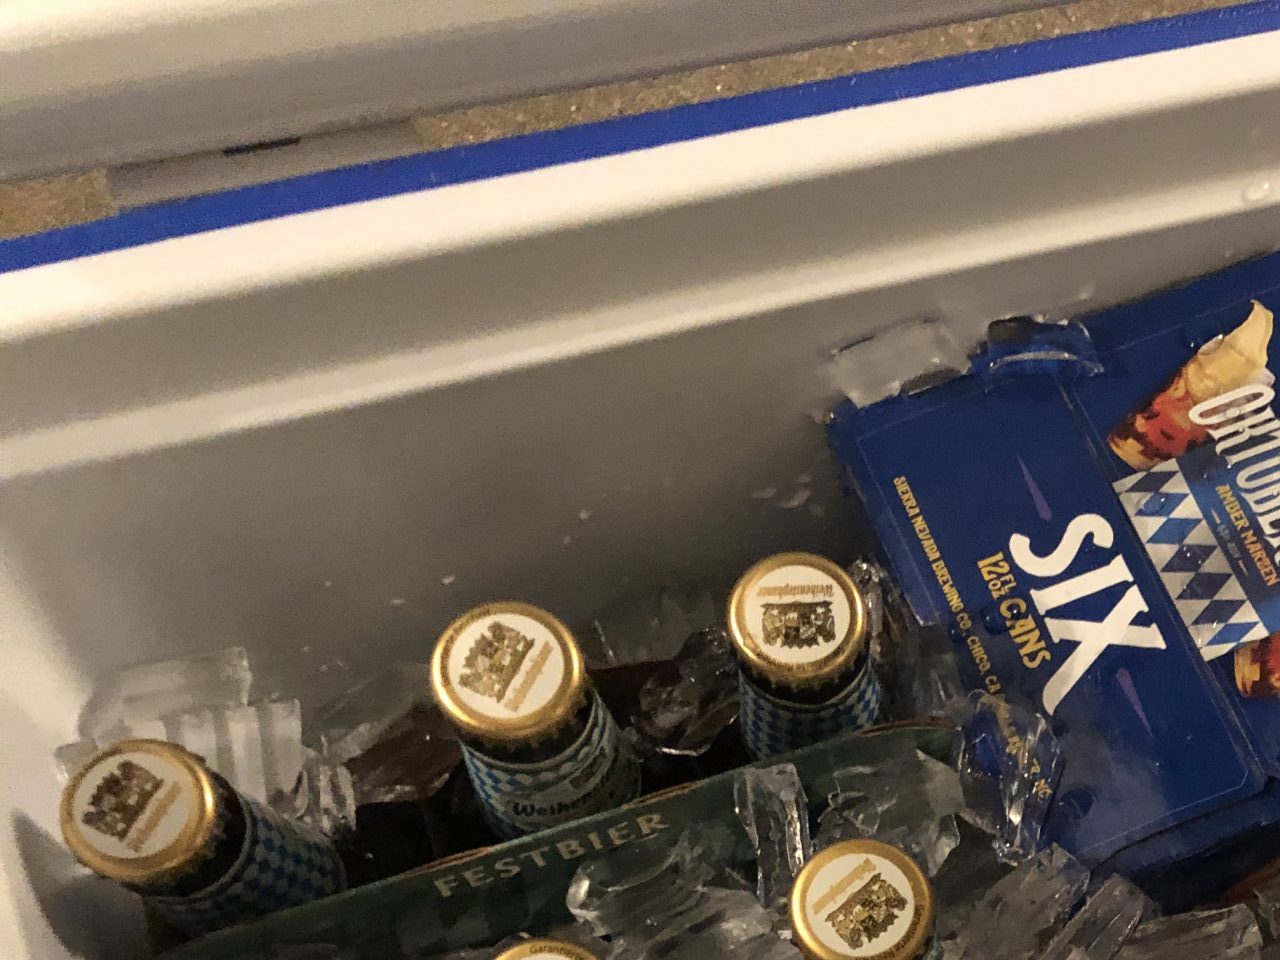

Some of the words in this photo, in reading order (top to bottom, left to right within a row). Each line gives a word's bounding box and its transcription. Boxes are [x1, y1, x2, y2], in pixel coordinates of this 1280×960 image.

[893, 475, 920, 517] SIERRA
[911, 515, 941, 561] NEVADA
[932, 559, 965, 613] BREWING
[1215, 483, 1250, 530] AMBER
[977, 551, 1010, 582] 12
[1000, 598, 1051, 669] CANS
[1009, 513, 1167, 716] SIX
[434, 813, 670, 897] FESTBIER
